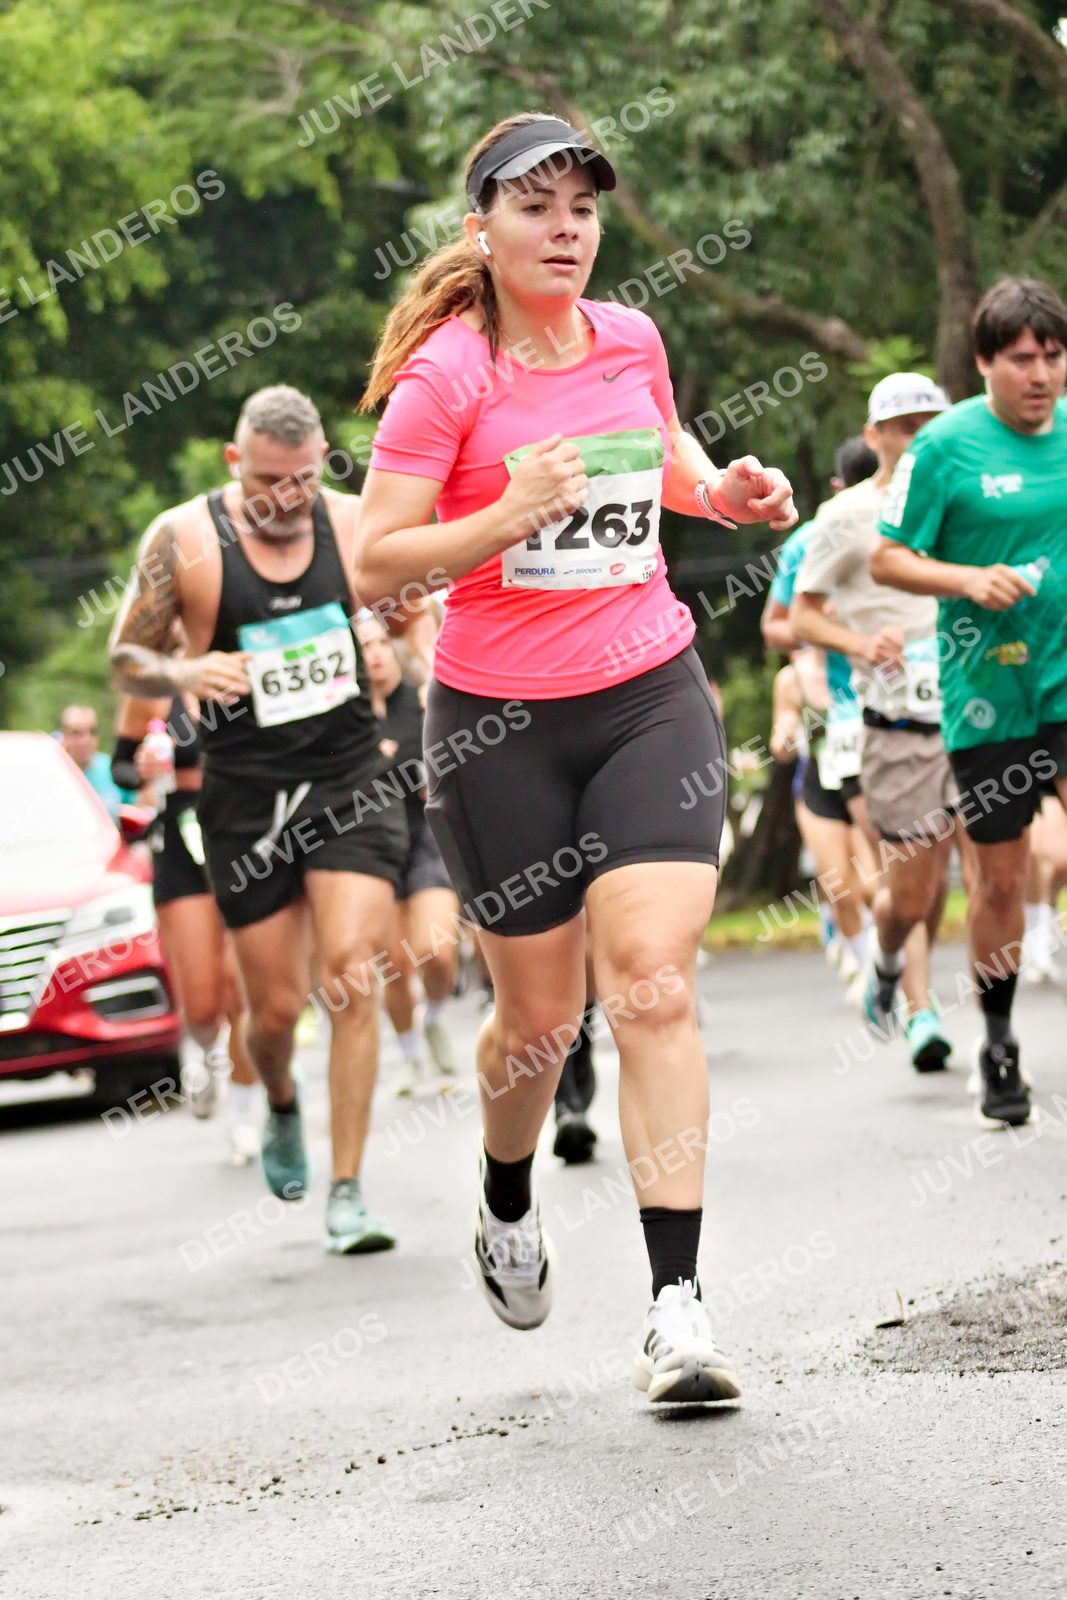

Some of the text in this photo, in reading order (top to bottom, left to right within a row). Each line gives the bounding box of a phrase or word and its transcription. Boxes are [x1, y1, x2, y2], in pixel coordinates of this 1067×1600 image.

[514, 567, 556, 576] PERDURA
[575, 567, 602, 575] BROOKS
[261, 651, 350, 697] 6362
